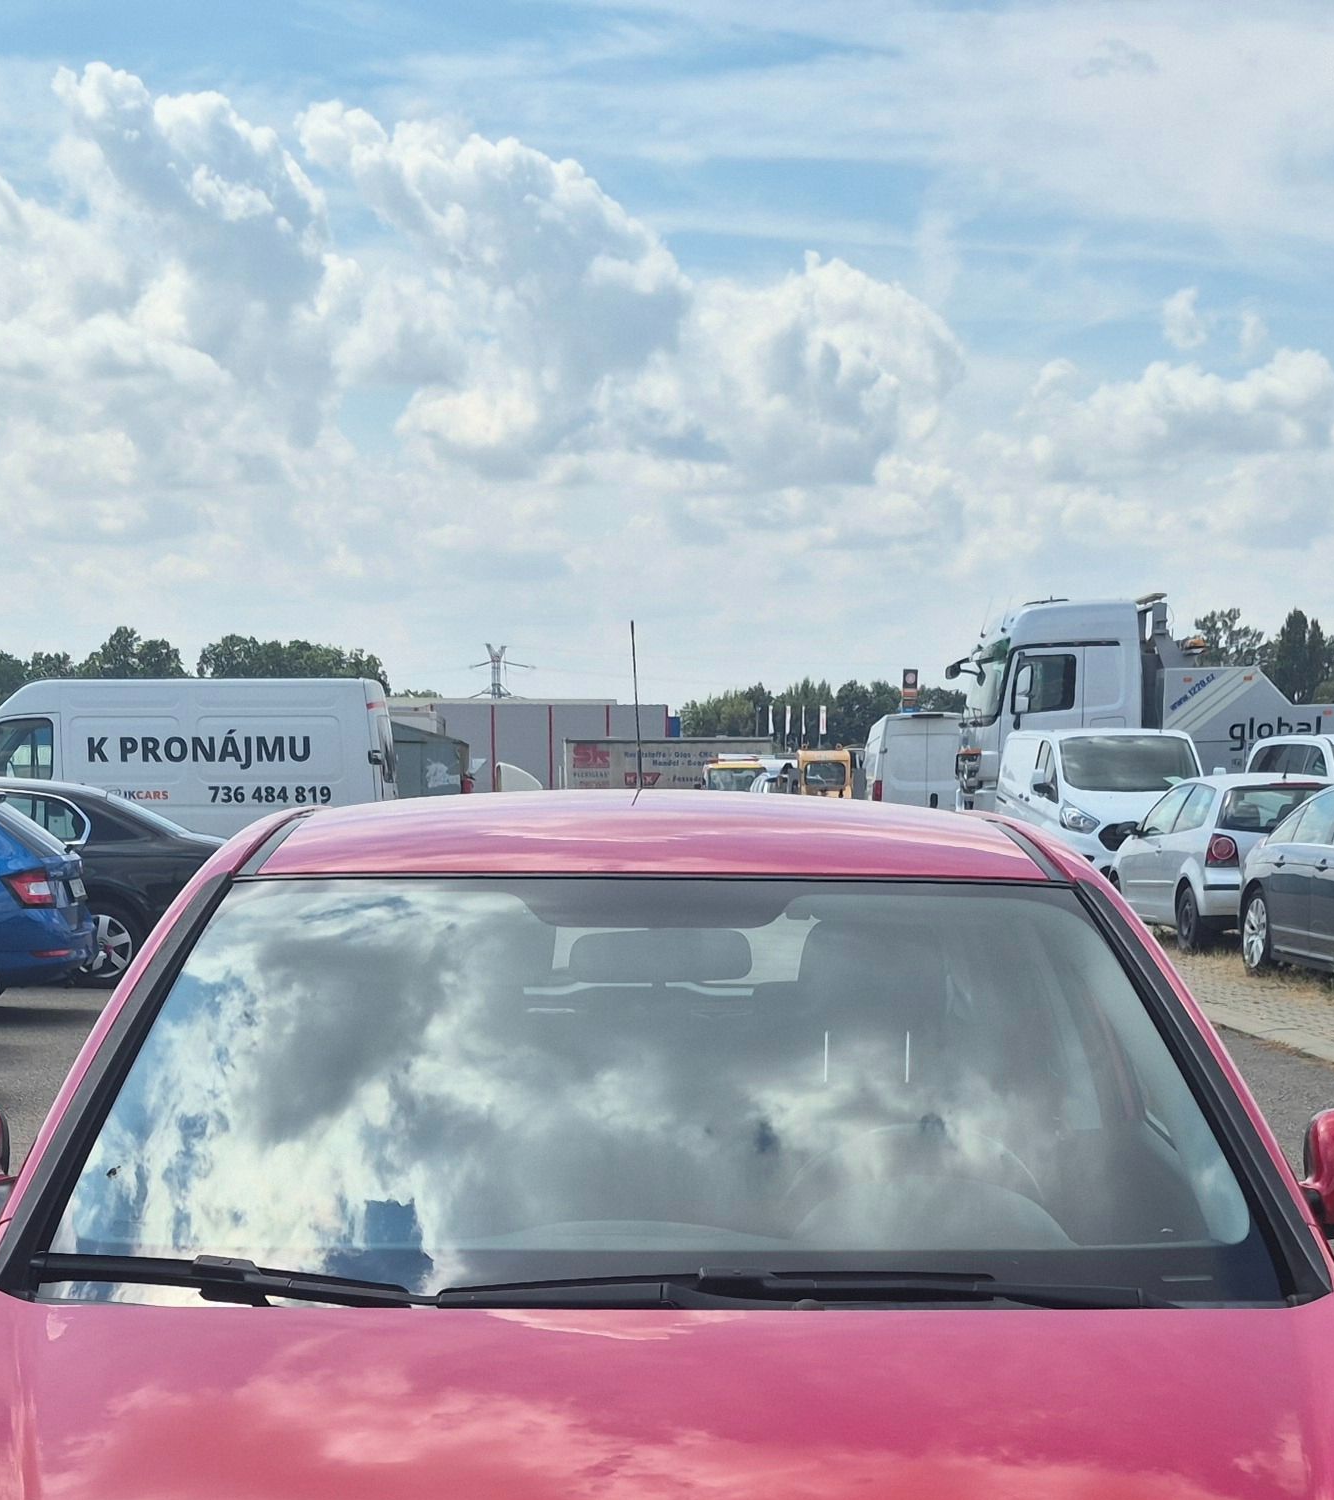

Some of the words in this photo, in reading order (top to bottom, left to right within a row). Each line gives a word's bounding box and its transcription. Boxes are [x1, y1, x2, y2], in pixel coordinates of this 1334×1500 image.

[87, 736, 109, 763] K
[119, 728, 312, 770] PRONÁJMU
[1229, 716, 1322, 751] global
[208, 786, 245, 803] 736
[251, 786, 289, 803] 484
[294, 786, 331, 804] 819
